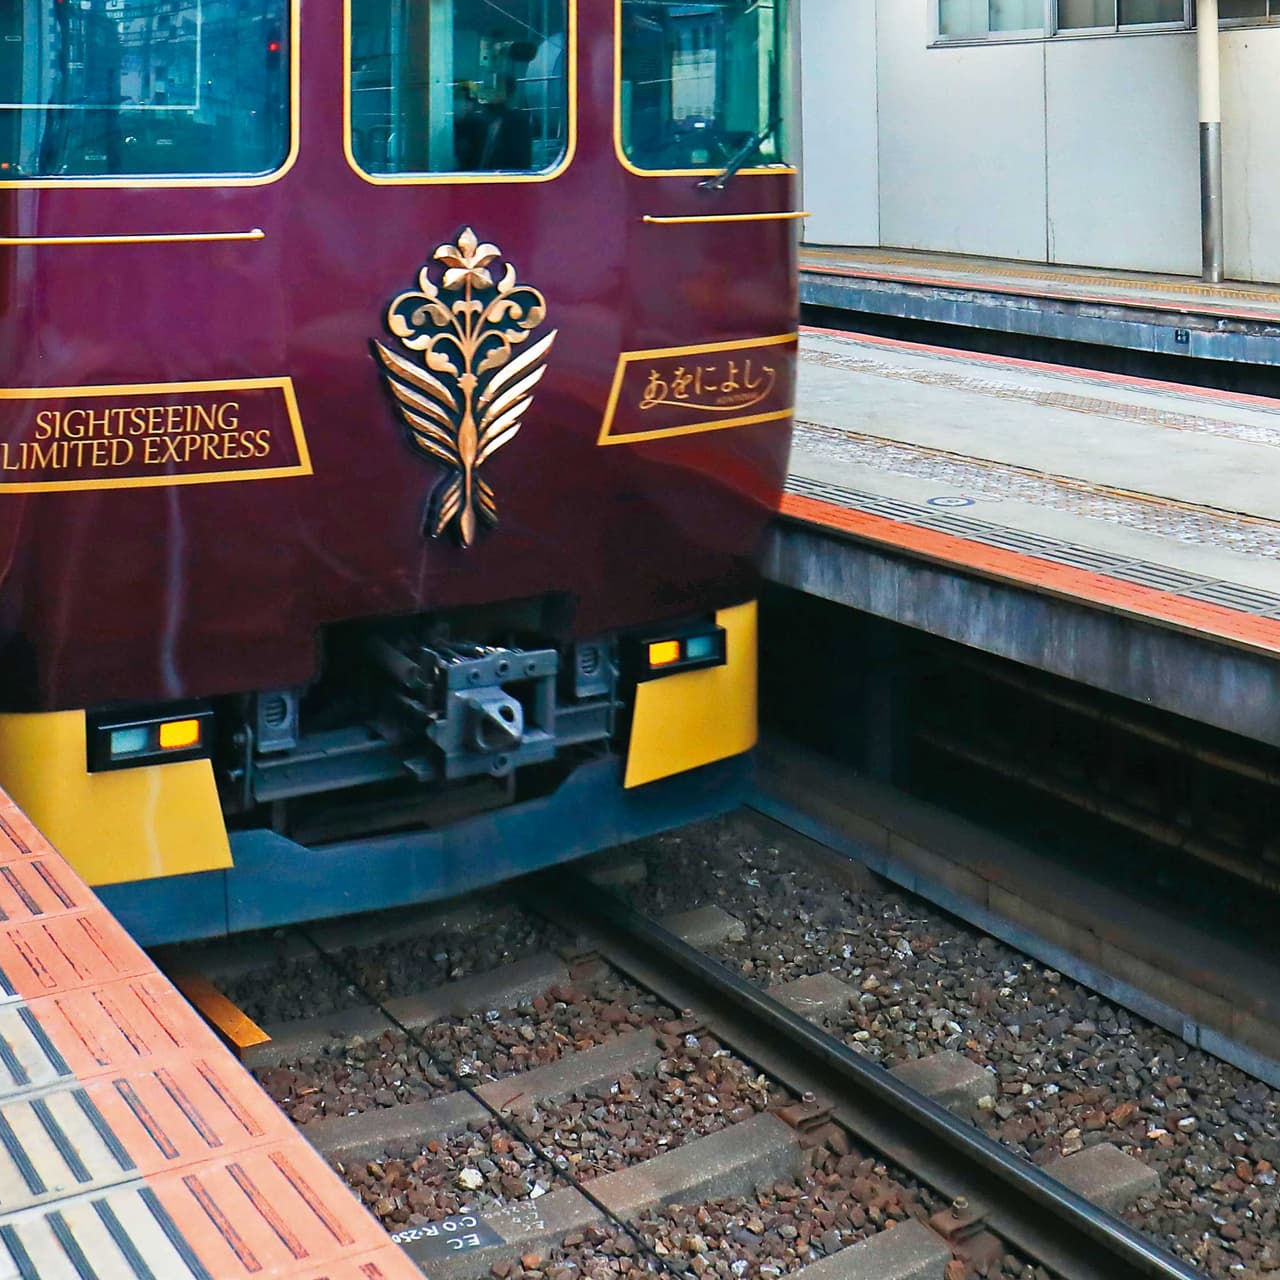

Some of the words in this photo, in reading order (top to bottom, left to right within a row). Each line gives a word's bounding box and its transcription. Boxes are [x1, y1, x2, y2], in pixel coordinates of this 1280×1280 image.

[34, 402, 240, 440] SIGHTSEEING
[0, 437, 134, 471] LIMITED
[142, 429, 271, 464] EXPRESS
